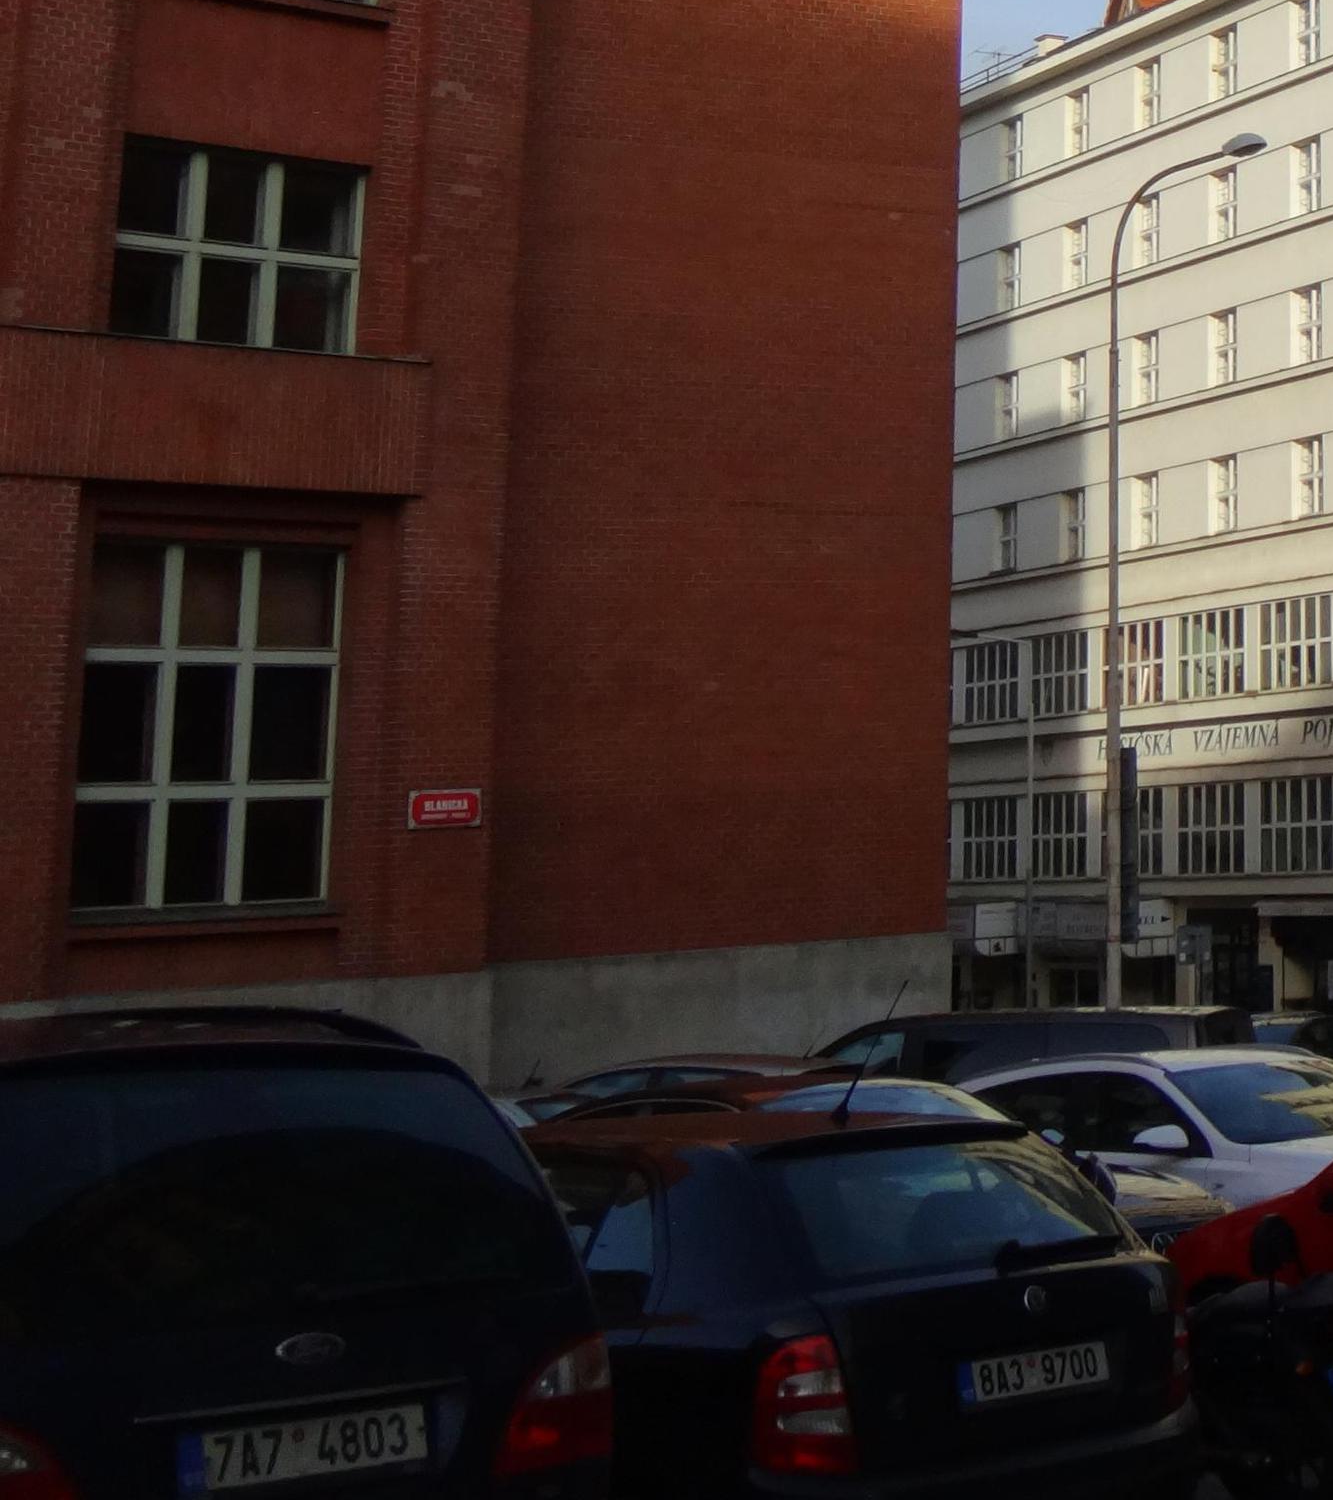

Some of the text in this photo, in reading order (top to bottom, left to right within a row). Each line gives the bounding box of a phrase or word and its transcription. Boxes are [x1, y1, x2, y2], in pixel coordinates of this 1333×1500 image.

[980, 1347, 1097, 1395] 8A3 9700
[213, 1413, 409, 1482] 7A7 4803
